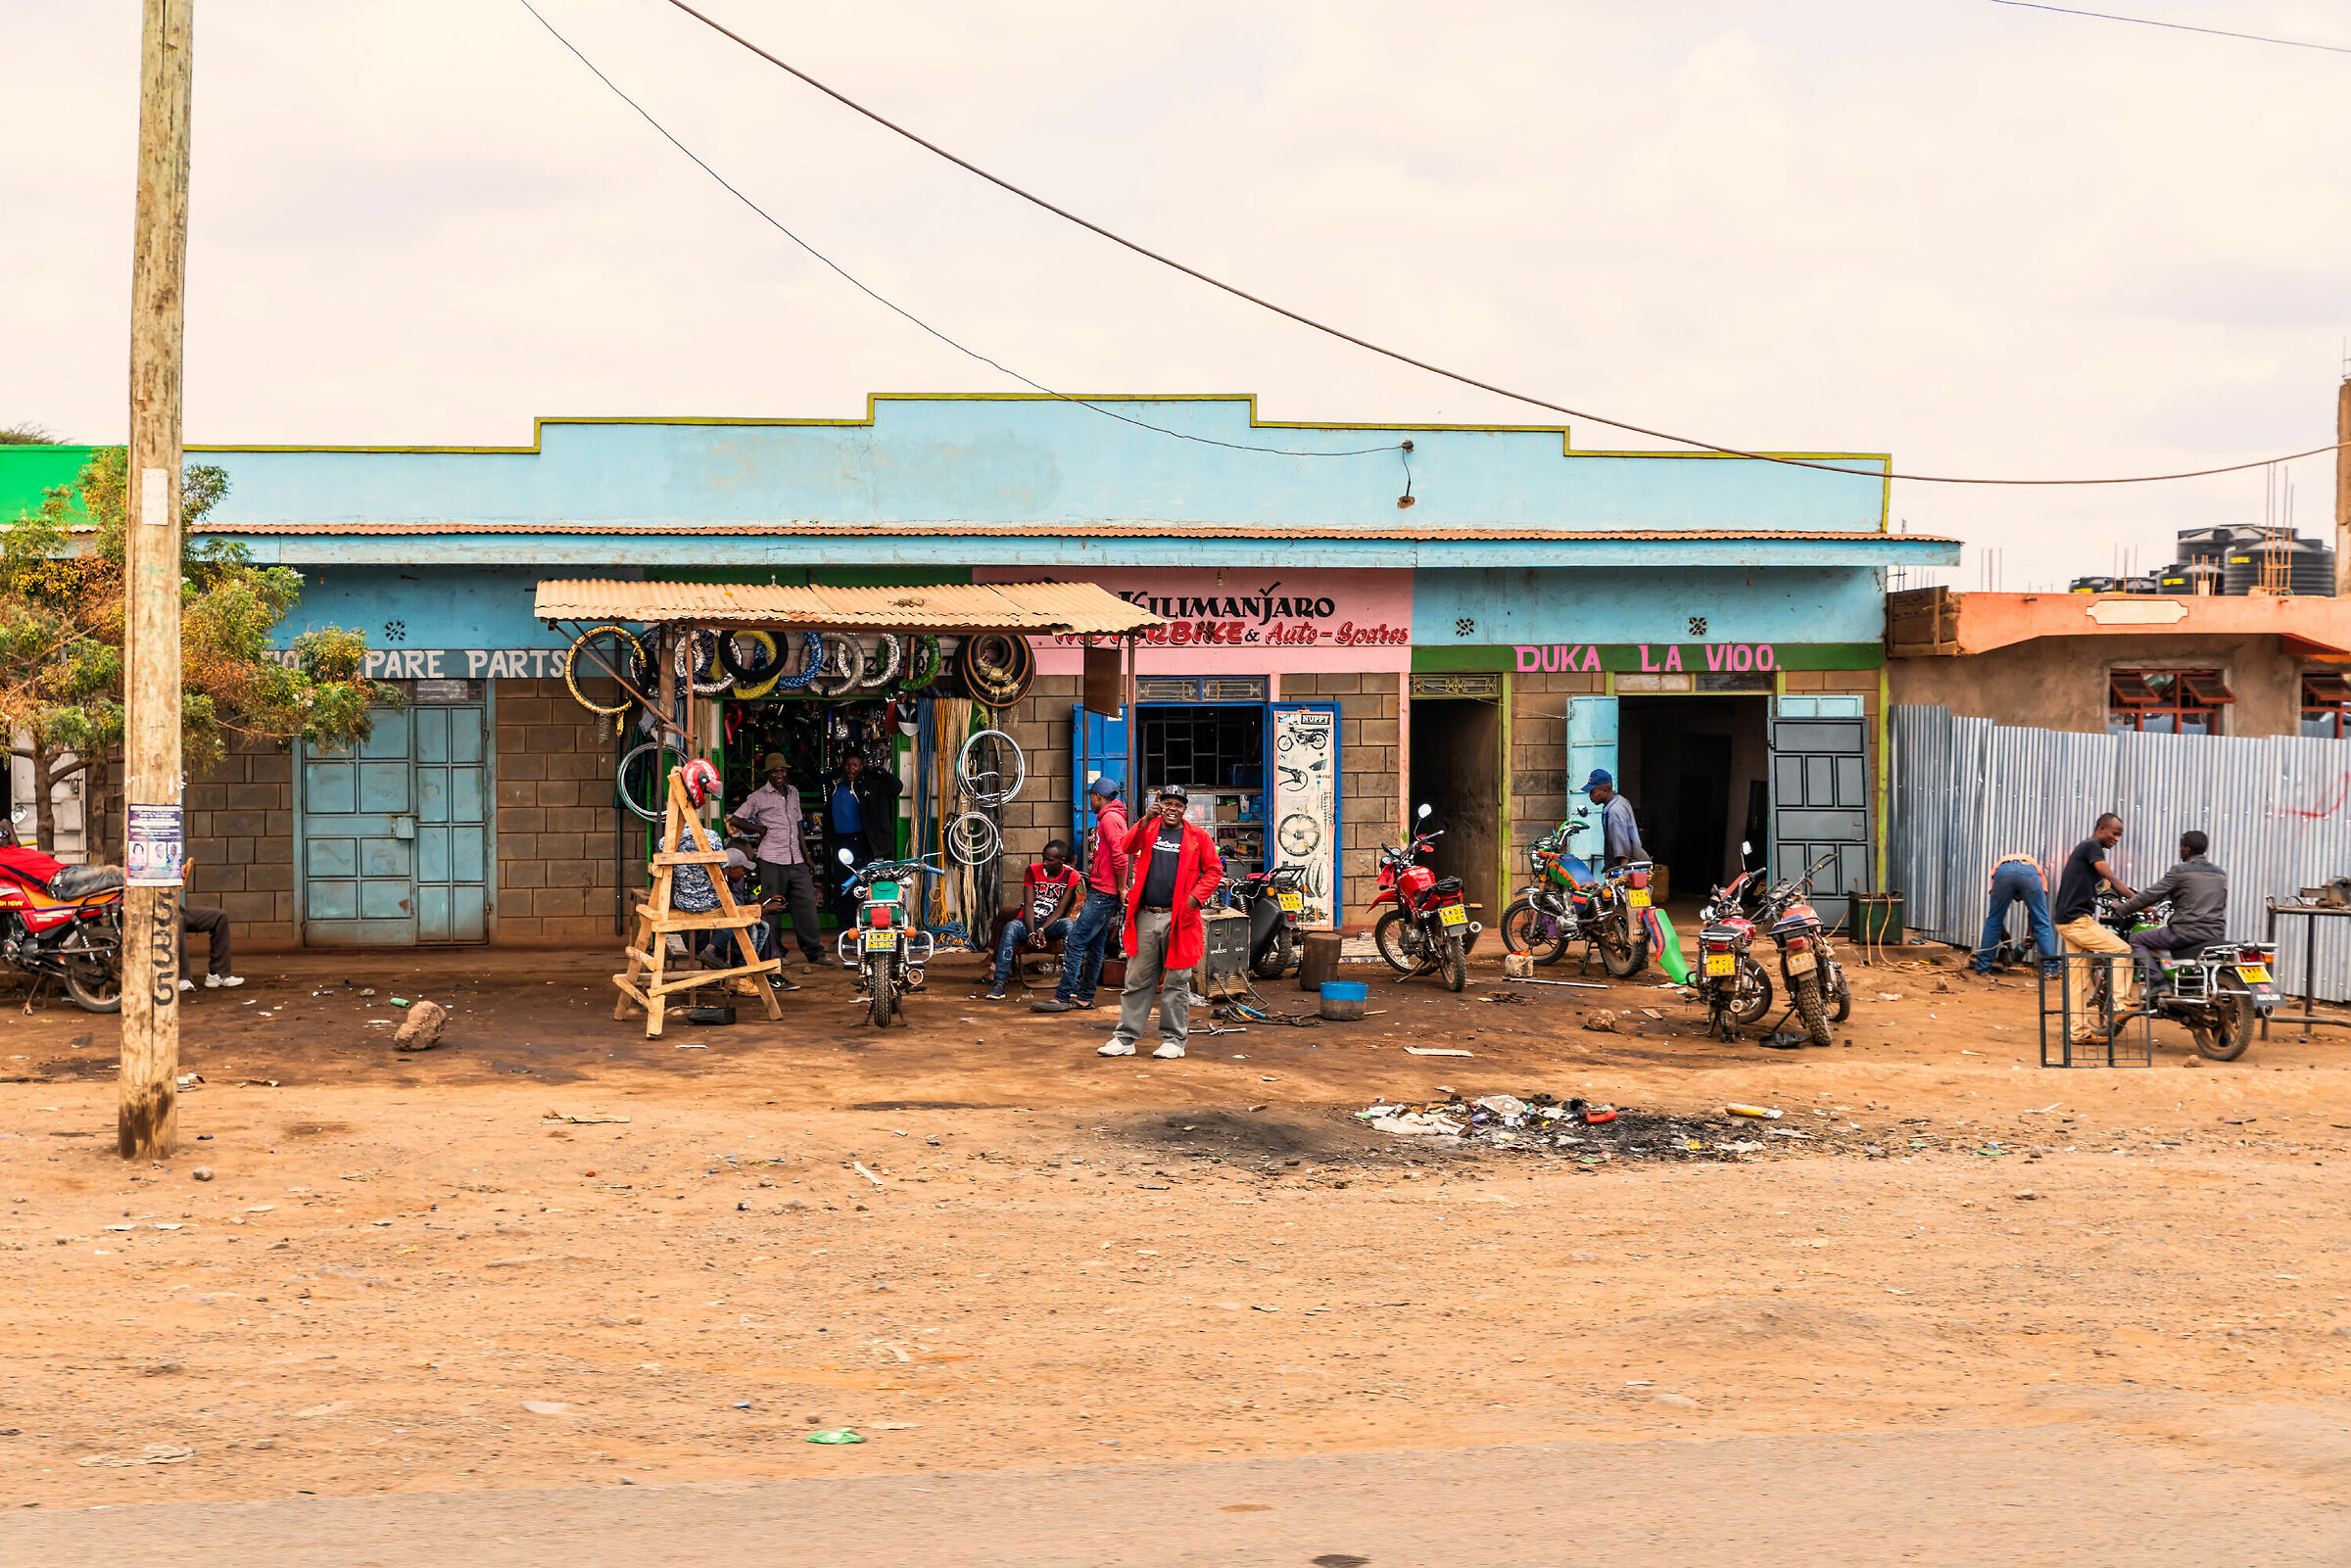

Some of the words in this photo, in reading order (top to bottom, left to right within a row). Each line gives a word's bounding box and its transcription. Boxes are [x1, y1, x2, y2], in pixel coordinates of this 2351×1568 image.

[1119, 582, 1336, 626] KILIMANJARO
[1055, 621, 1245, 645] RBIKE
[1244, 629, 1260, 642] &
[362, 650, 445, 679] PARE
[464, 649, 567, 679] PARTS
[1512, 645, 1602, 672] DUKA
[1639, 645, 1683, 672] LA
